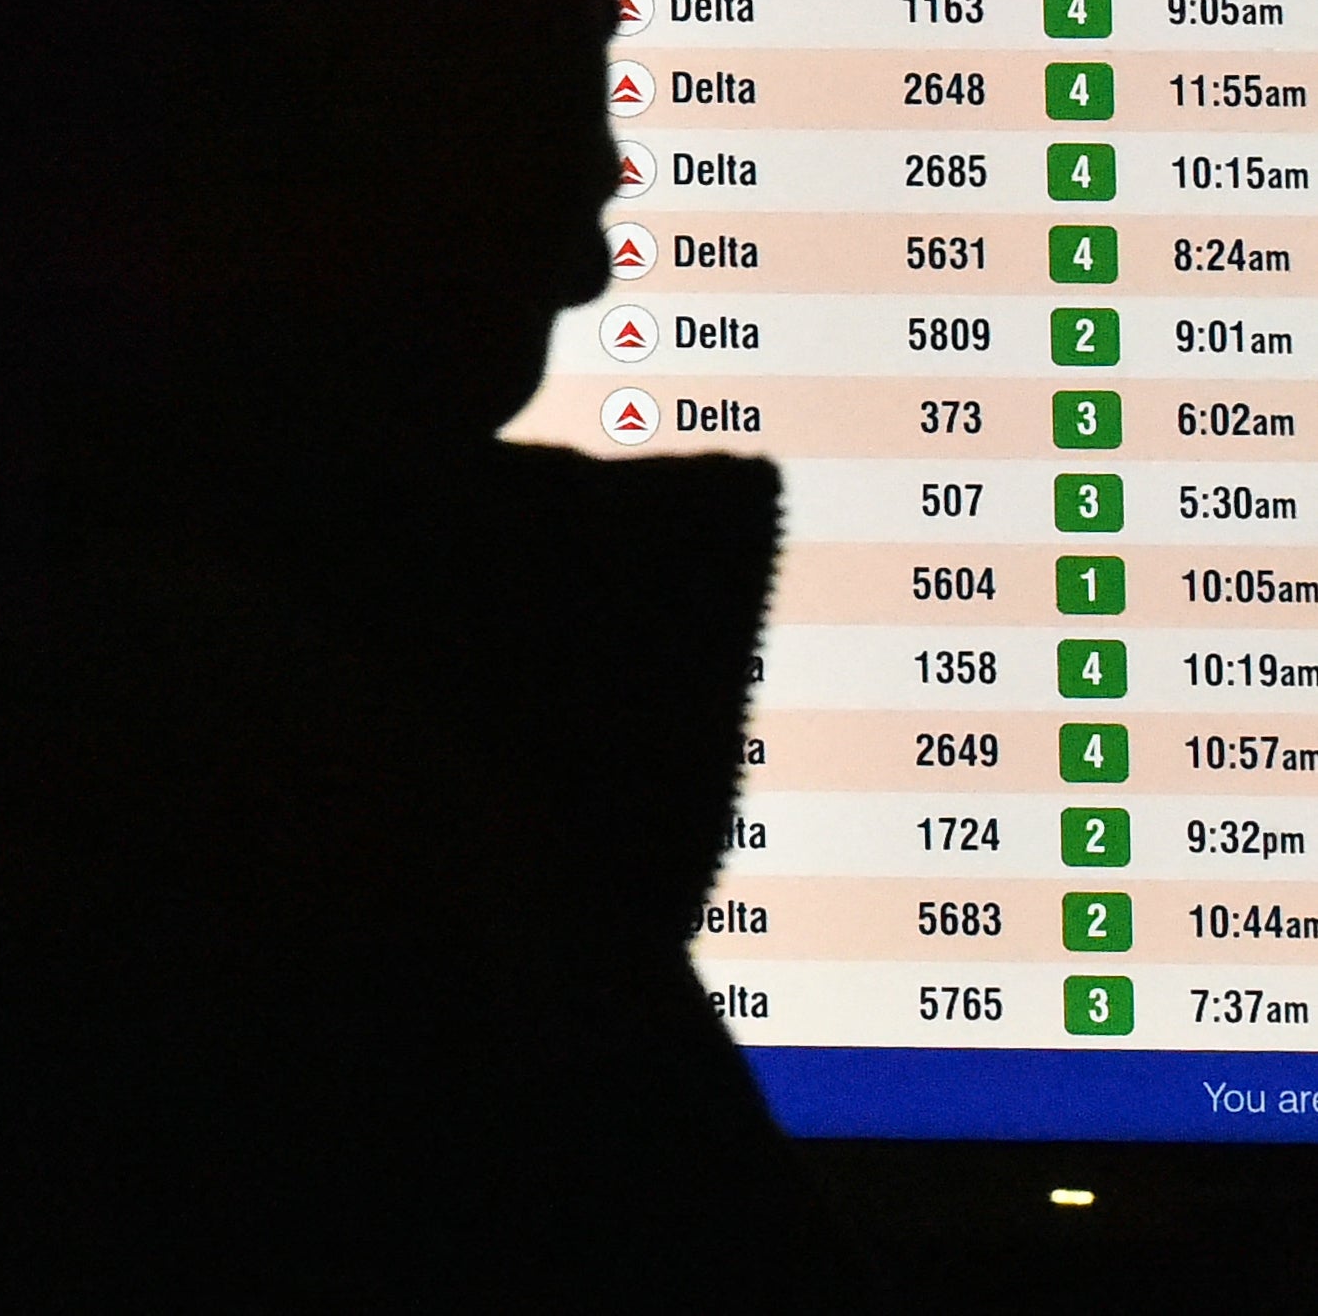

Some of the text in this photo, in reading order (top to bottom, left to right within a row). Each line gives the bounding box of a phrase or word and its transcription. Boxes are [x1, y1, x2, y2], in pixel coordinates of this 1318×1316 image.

[673, 152, 1309, 190] Delta 2685 4 10:15am
[676, 398, 1295, 437] Delta 373 3 6:02am
[917, 817, 1305, 861] 1724 2 9:32pm
[709, 984, 1309, 1024] elta 5765 3 7:37am
[1202, 1081, 1266, 1114] You
